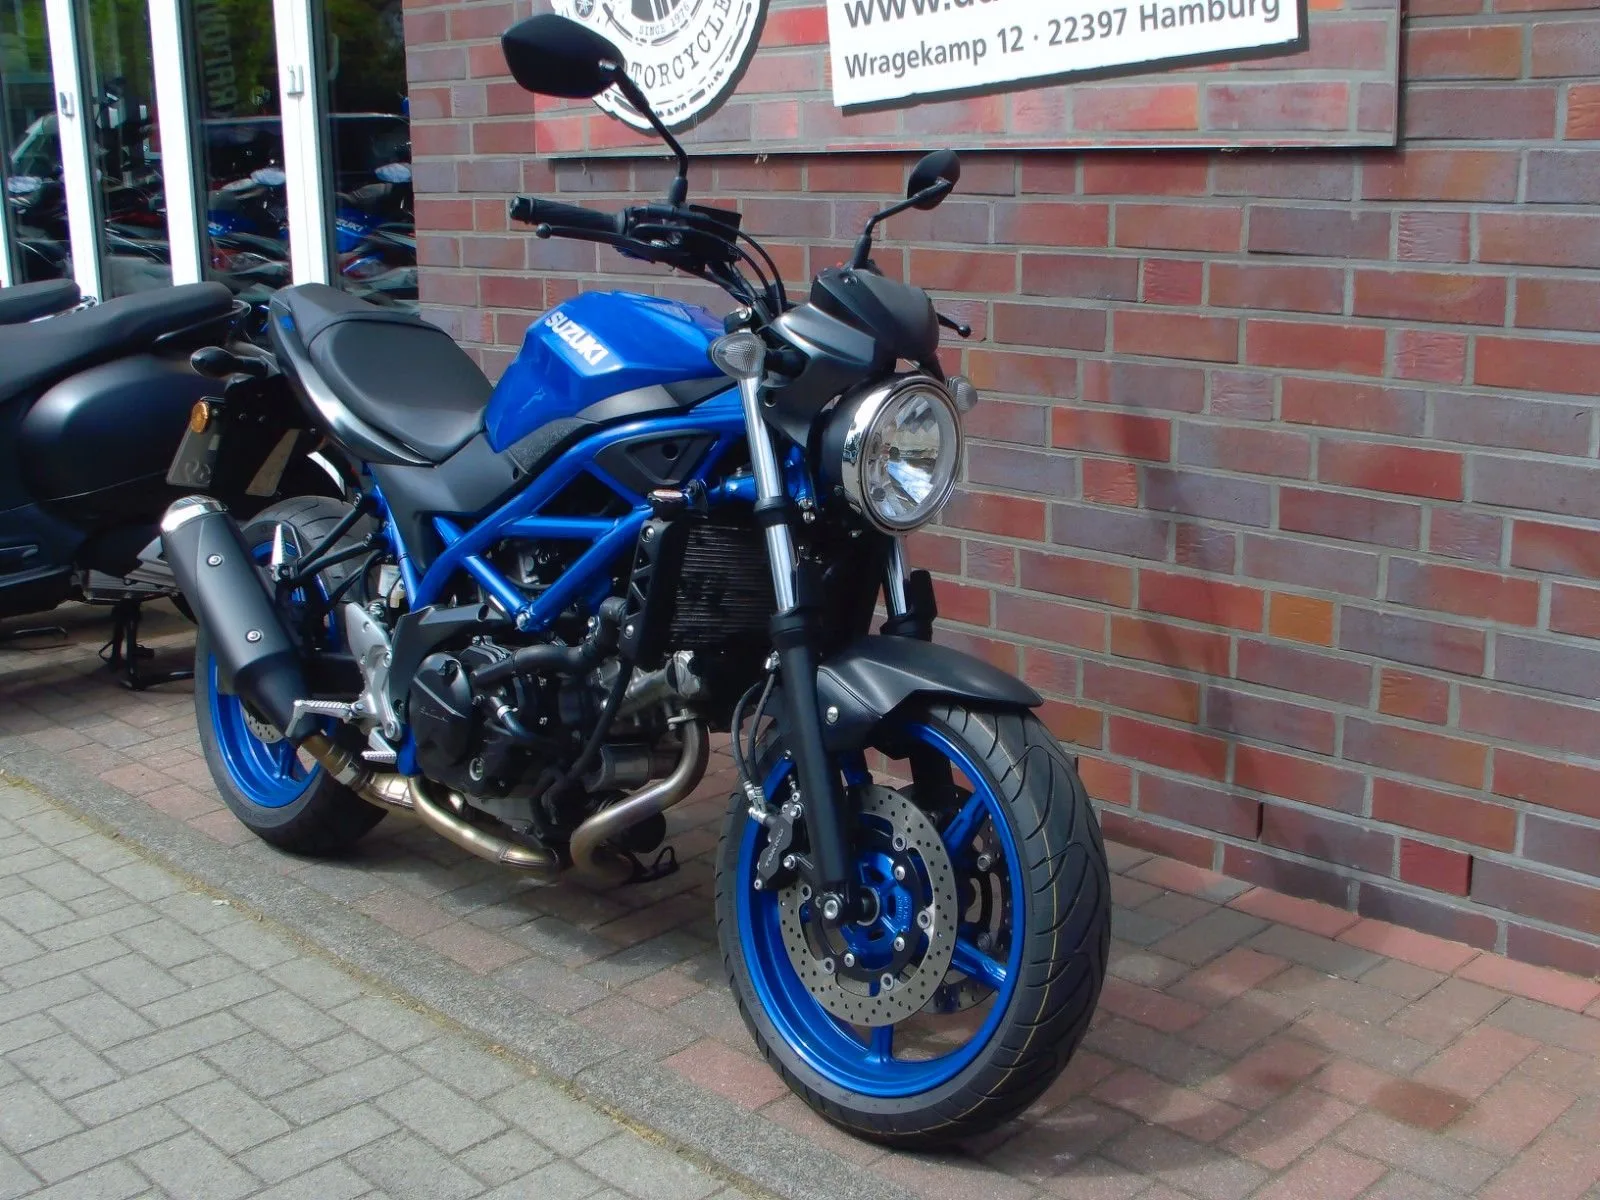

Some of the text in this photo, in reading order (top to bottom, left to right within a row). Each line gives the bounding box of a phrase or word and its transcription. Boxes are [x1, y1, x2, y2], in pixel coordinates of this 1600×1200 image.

[623, 0, 732, 89] TORCYCLE
[638, 23, 666, 37] SINCE
[844, 0, 1280, 79] Wragekamp 12 22397 Hamburg
[544, 311, 609, 366] SUZUKI
